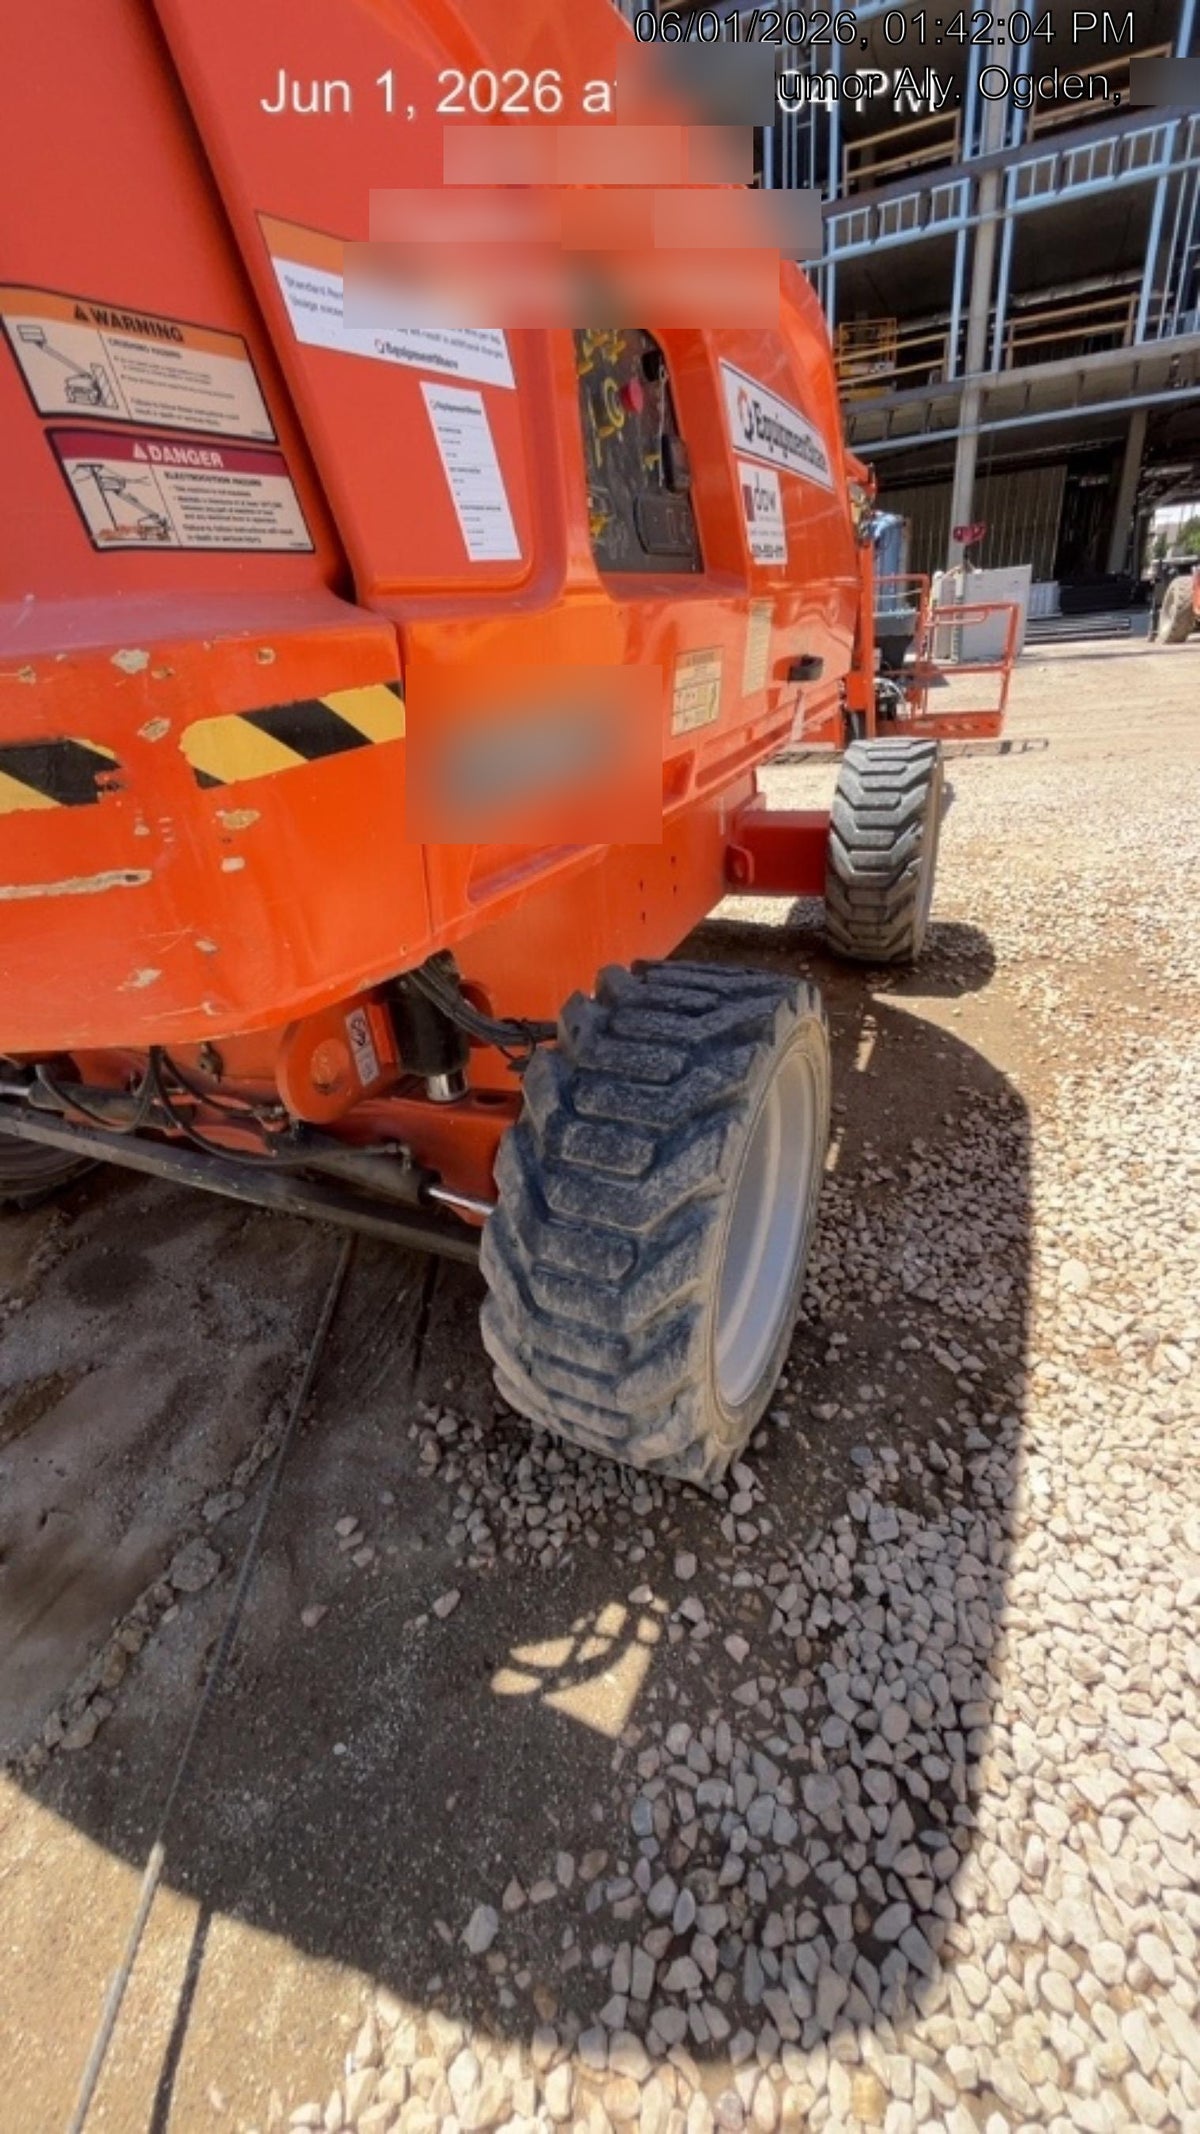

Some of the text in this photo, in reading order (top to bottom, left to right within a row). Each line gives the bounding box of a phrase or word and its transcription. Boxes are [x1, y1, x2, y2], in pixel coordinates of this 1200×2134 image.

[89, 306, 184, 342] WARNING
[385, 340, 458, 369] EquipmentShare
[149, 444, 224, 469] DANGER
